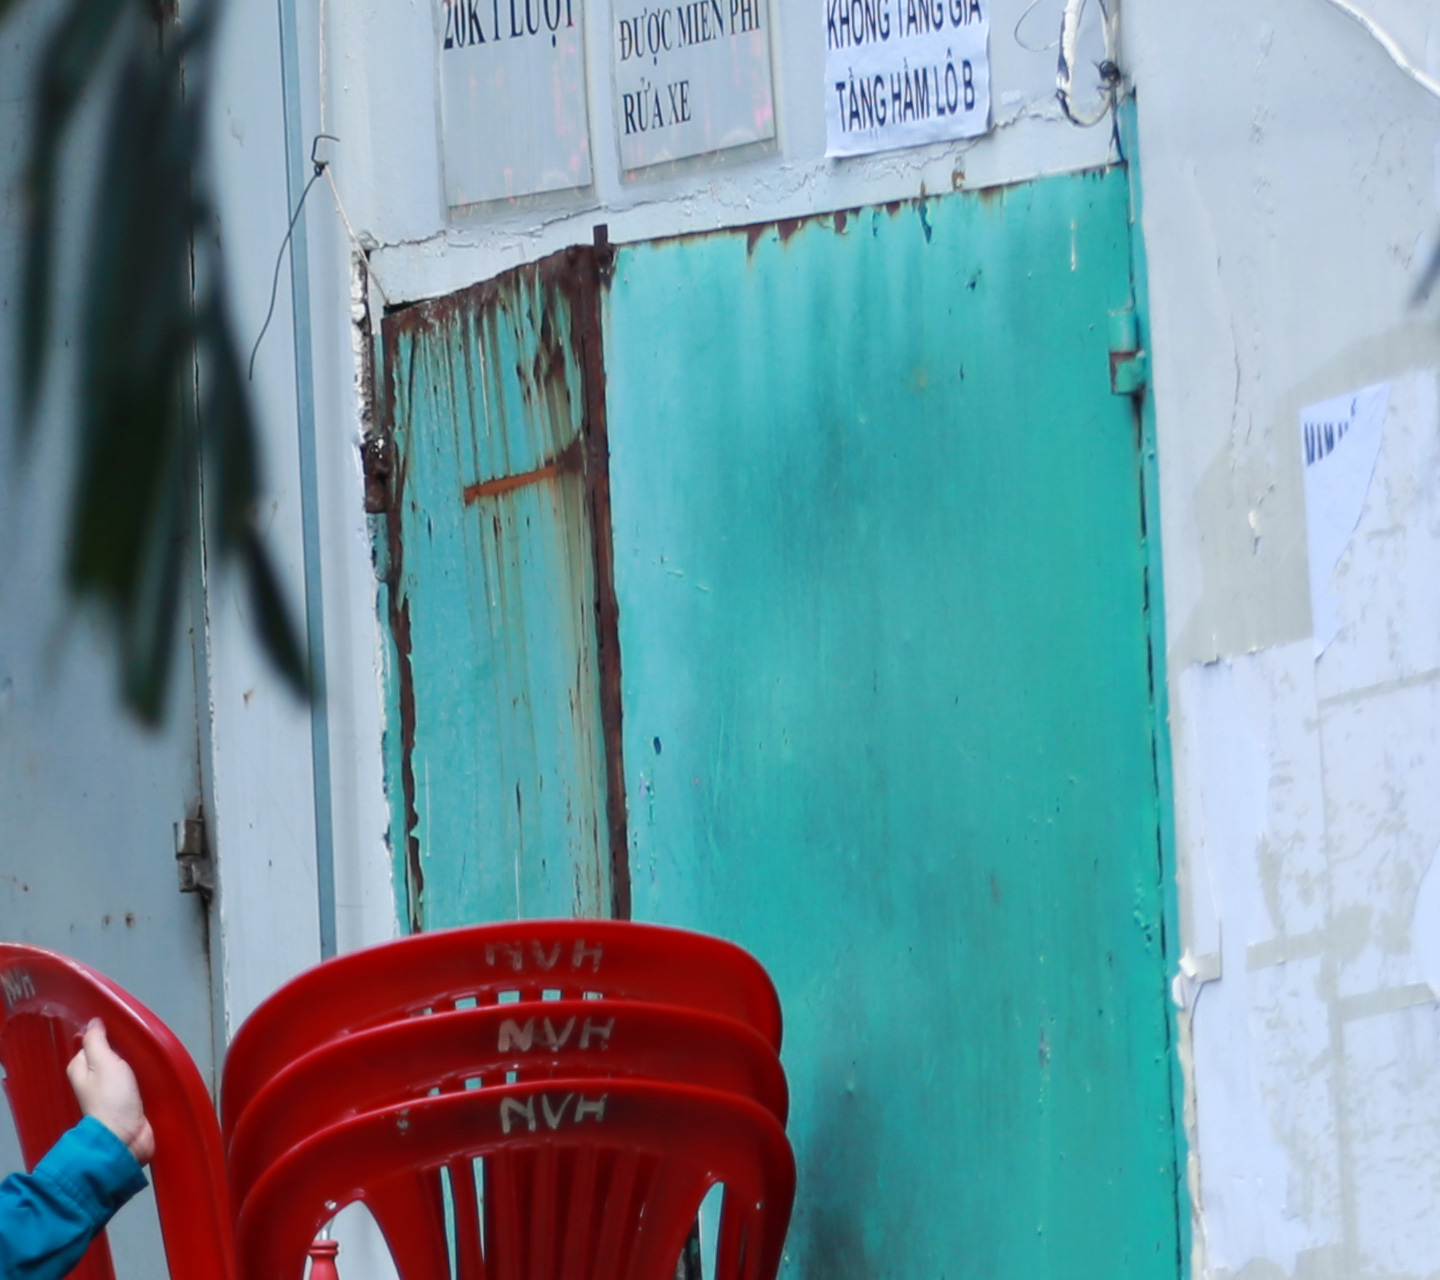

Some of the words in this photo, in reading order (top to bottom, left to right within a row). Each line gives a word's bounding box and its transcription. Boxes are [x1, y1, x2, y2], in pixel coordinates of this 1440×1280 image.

[619, 8, 672, 66] ĐƯỢC
[668, 80, 692, 125] XE
[933, 47, 958, 116] LÔ
[962, 59, 975, 113] B
[498, 1015, 615, 1052] NVH
[499, 1092, 608, 1134] NVH
